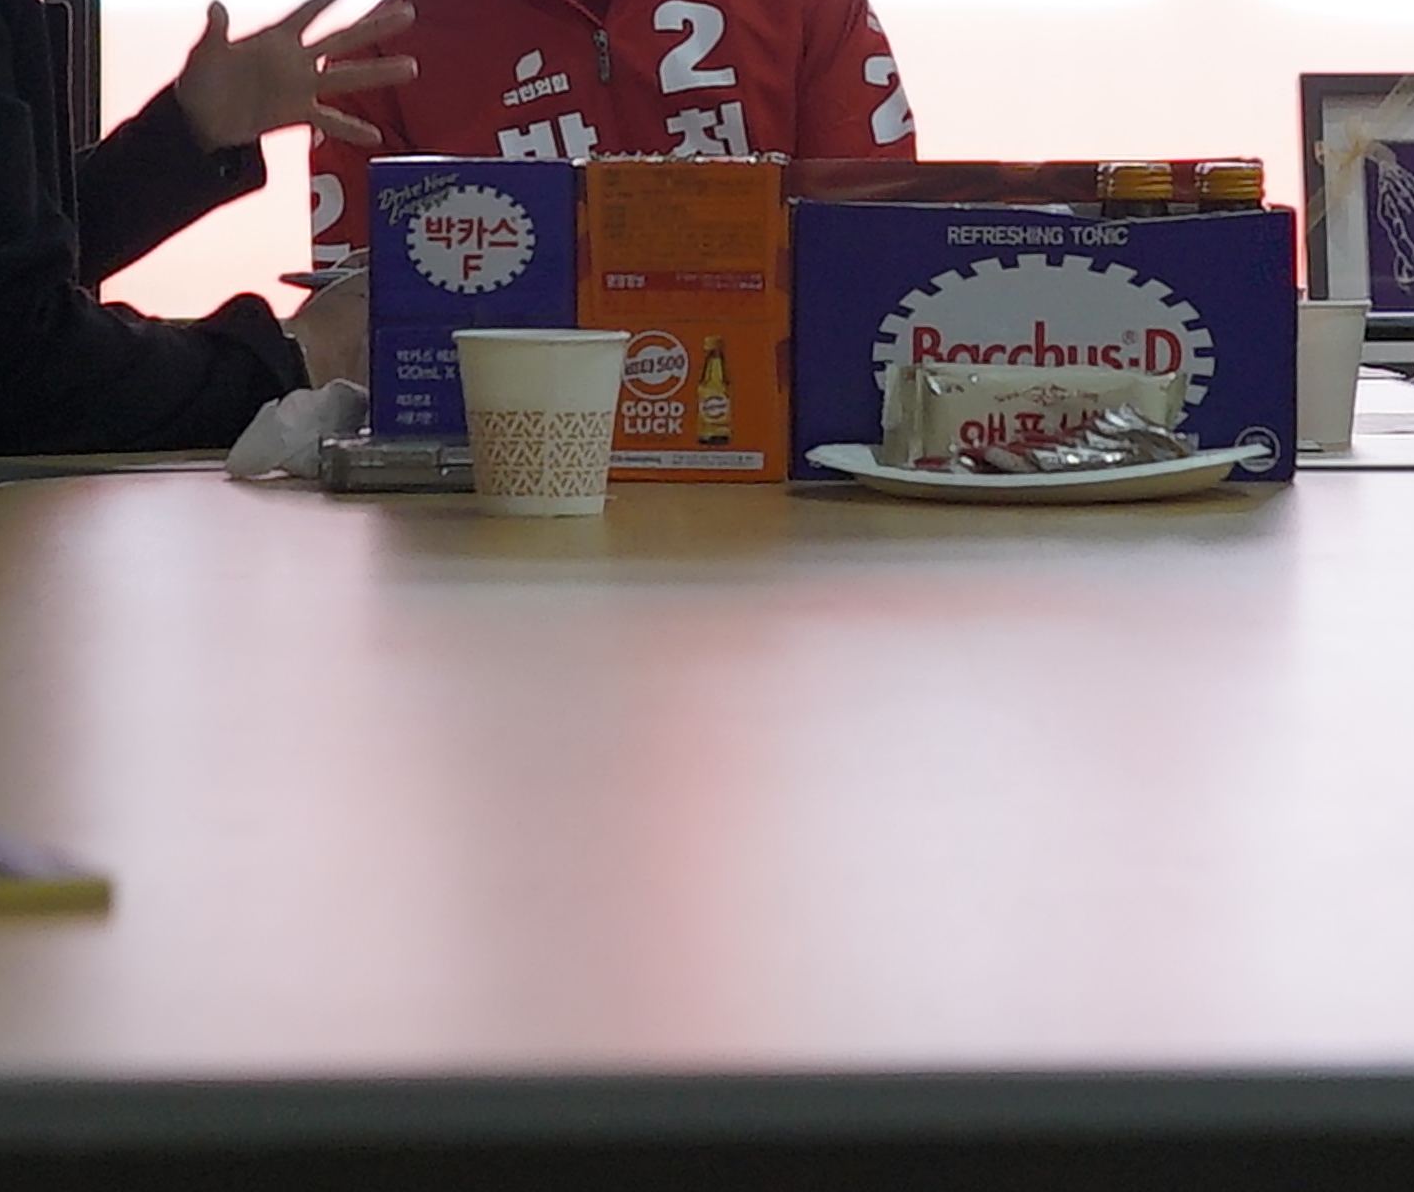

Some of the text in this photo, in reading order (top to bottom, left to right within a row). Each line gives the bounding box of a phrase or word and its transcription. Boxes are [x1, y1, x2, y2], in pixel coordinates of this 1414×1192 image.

[654, 0, 737, 94] 2
[503, 73, 570, 107] 국민의힘
[864, 55, 915, 145] 2
[425, 216, 519, 249] 박카스
[947, 225, 1130, 246] REFRESHING TONIC
[463, 254, 484, 280] F
[621, 400, 684, 417] GOOD
[623, 417, 684, 434] LUCK
